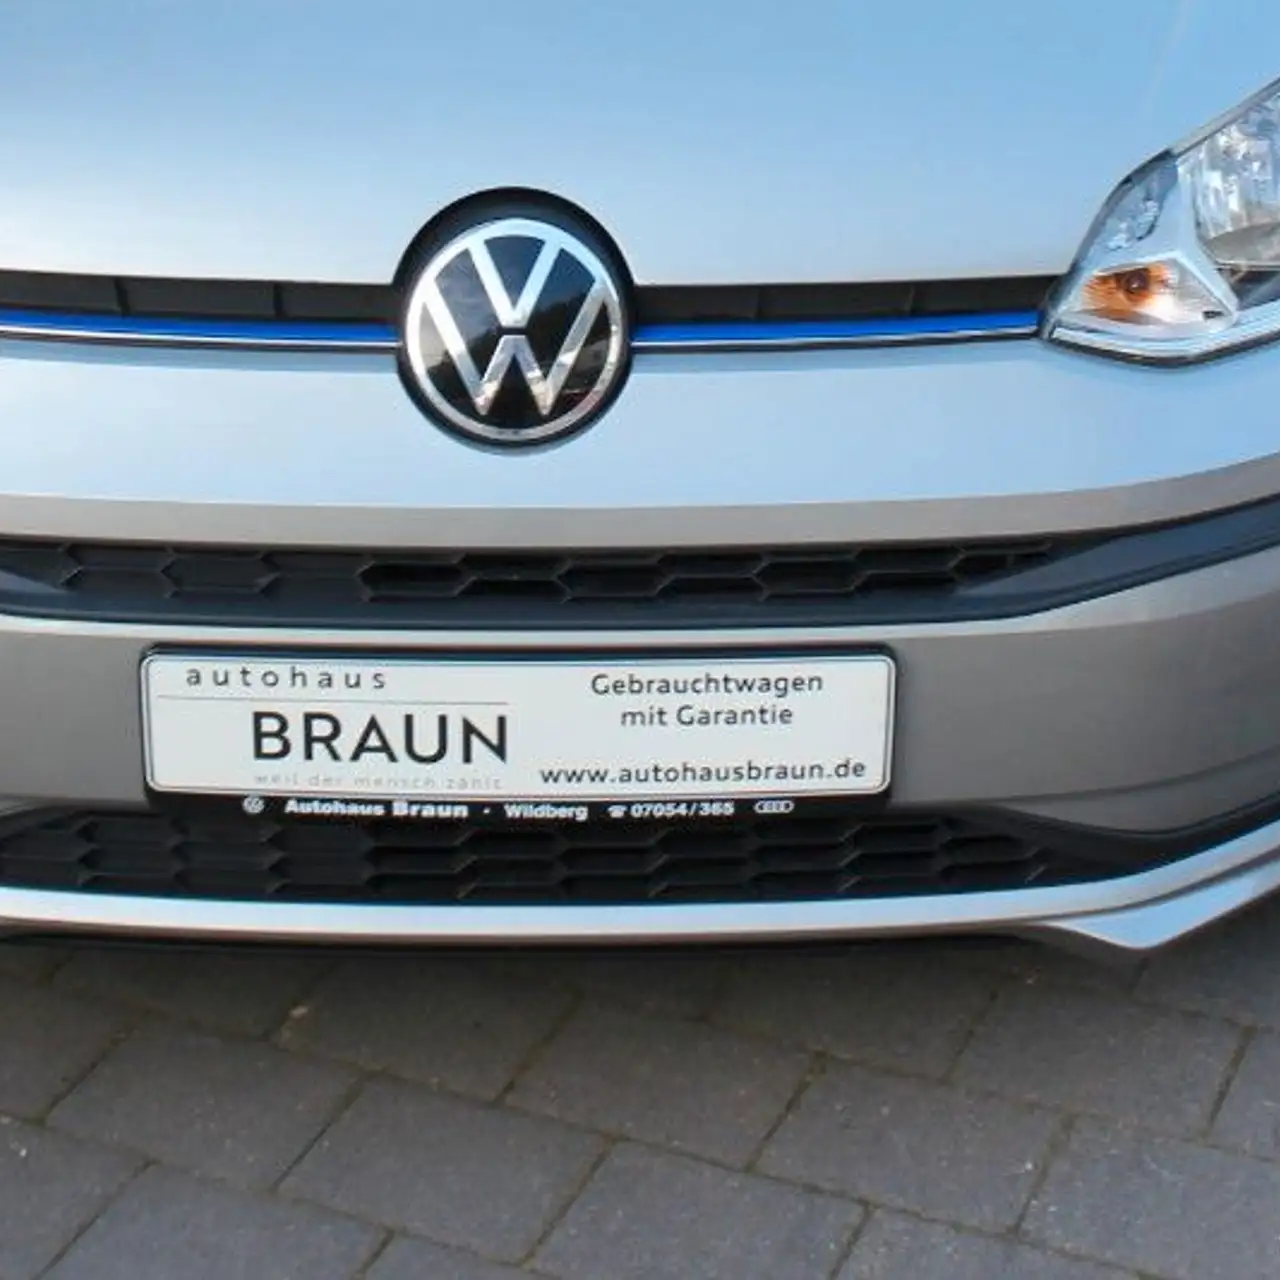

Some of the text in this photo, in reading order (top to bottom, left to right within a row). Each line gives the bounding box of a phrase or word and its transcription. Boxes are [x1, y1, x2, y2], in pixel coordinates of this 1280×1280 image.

[186, 666, 387, 689] autohaus
[591, 673, 824, 699] Gebrauchtwagen
[621, 704, 793, 726] mit Garantie
[252, 711, 508, 764] BRAUN
[540, 758, 866, 784] www.autohausbraun.de
[284, 799, 386, 817] Autohaus
[392, 799, 469, 818] Braun
[504, 803, 589, 820] Wildberg
